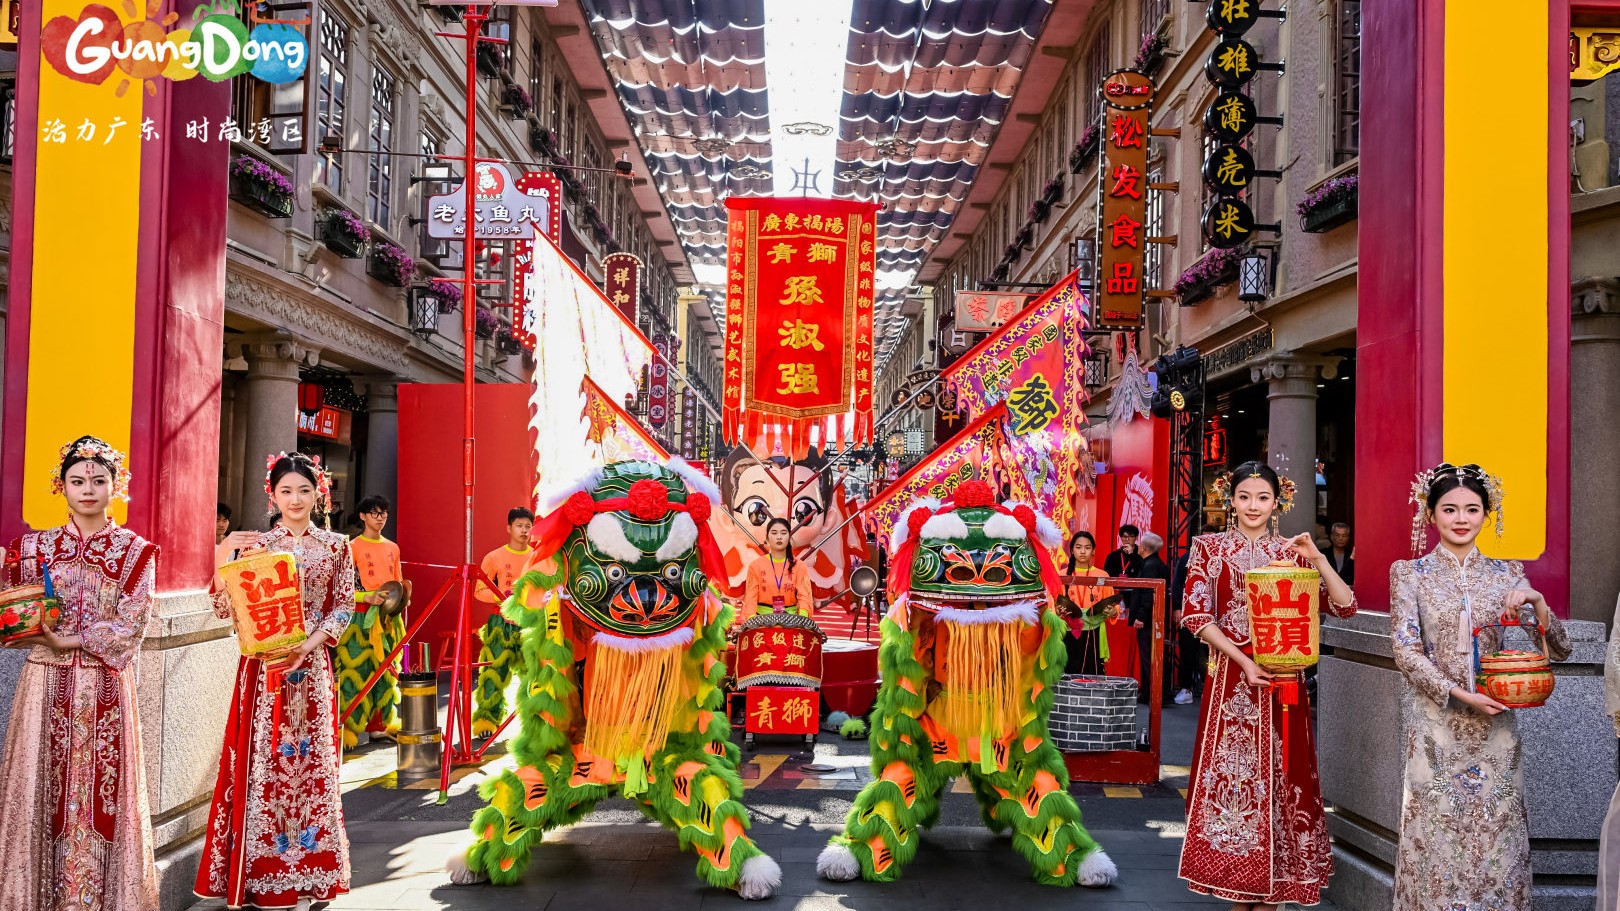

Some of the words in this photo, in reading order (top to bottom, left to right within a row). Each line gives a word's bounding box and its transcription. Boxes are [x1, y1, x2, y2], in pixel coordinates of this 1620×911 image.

[1106, 114, 1143, 295] 松发食品
[454, 226, 521, 235] 始1958年
[761, 213, 845, 235] 廣東揭陽
[766, 242, 838, 265] 青獅
[239, 560, 306, 642] 汕頭
[1248, 578, 1312, 656] 汕頭
[754, 652, 806, 668] 青獅
[750, 696, 813, 730] 青獅
